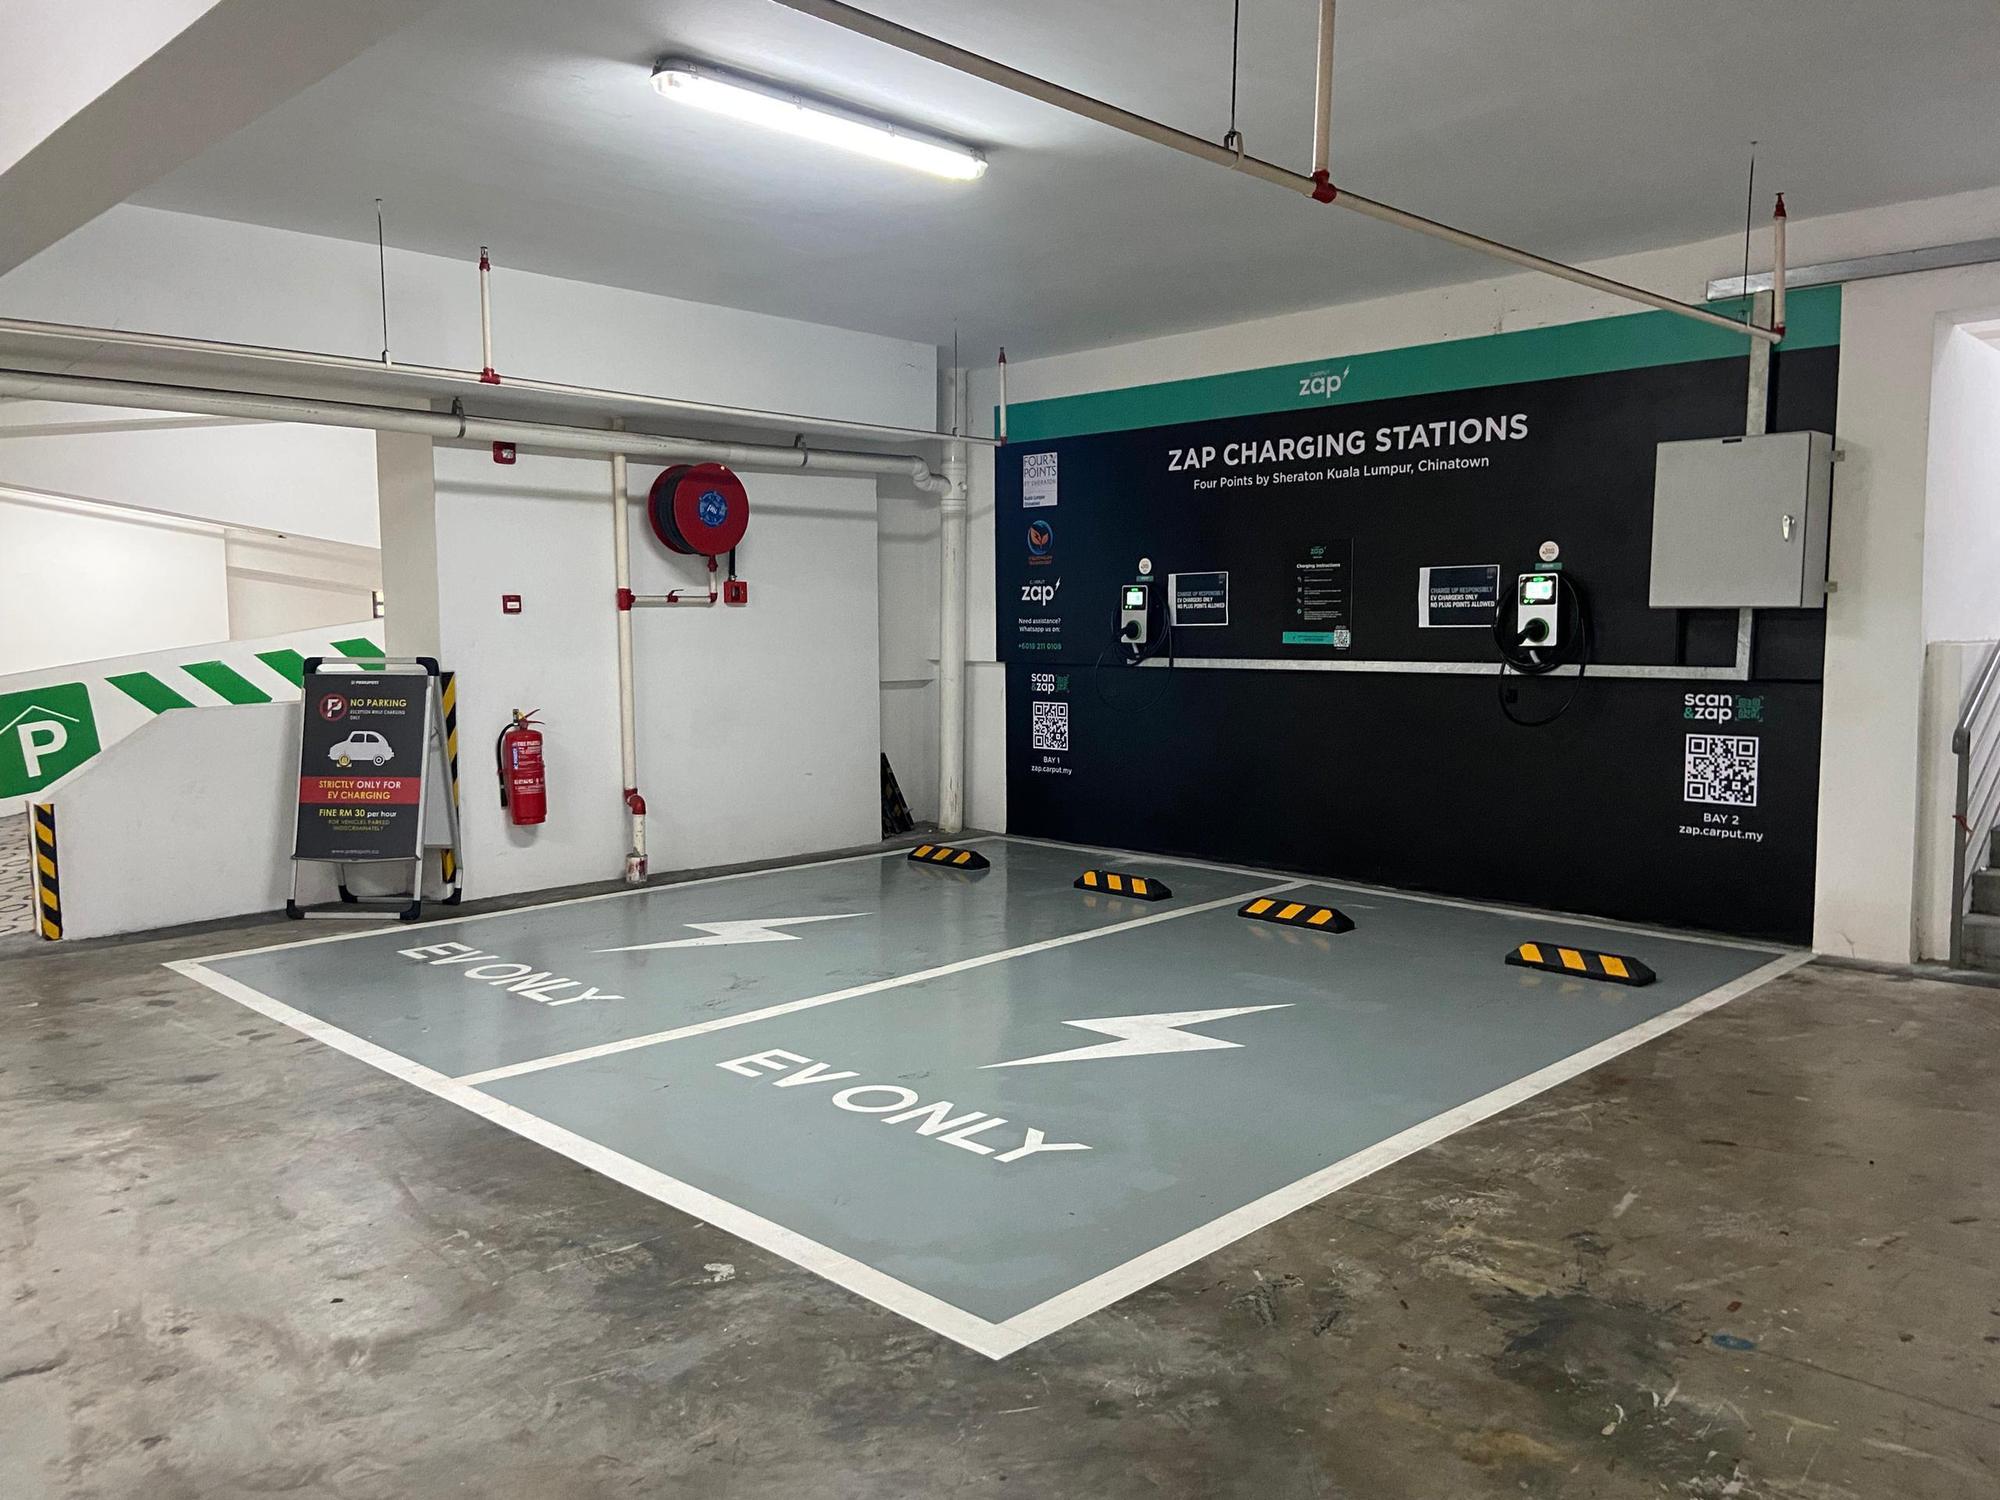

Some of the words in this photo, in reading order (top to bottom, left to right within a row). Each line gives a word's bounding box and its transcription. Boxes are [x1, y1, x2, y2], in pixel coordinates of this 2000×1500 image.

[1299, 375, 1341, 399] zap
[1168, 446, 1216, 471] ZAP
[1223, 430, 1366, 466] CHARGING
[1375, 413, 1528, 452] STATIONS
[1023, 455, 1048, 467] FOUR
[1024, 466, 1057, 479] POINTS
[1194, 479, 1217, 490] Four
[1220, 475, 1253, 488] Points
[1256, 473, 1269, 486] by
[1273, 470, 1323, 484] Sheraton
[1327, 466, 1360, 479] Kuala
[1364, 462, 1414, 477] Lumpur,
[1418, 457, 1489, 472] Chinatown
[1021, 585, 1054, 606] zap
[1031, 673, 1055, 682] scan
[350, 699, 364, 707] NO
[367, 699, 407, 707] PARKING
[1684, 693, 1732, 707] scan
[1683, 707, 1732, 724] &zap
[17, 720, 68, 778] P
[1043, 755, 1056, 763] BAY
[1031, 765, 1072, 775] zap.carput.my
[319, 780, 354, 789] STRICTLY
[356, 780, 381, 789] ONLY
[383, 780, 402, 789] FOR
[328, 791, 339, 799] EV
[340, 791, 391, 800] CHARGING
[319, 808, 337, 817] FINE
[339, 808, 353, 817] RM
[354, 808, 366, 817] 30
[380, 810, 397, 818] hour
[1703, 812, 1729, 824] BAY
[1731, 815, 1740, 825] 2
[1679, 824, 1764, 843] zap.carput.my
[397, 941, 499, 965] EV
[464, 962, 625, 1007] ONLY
[716, 1048, 861, 1089] EV
[832, 1084, 1093, 1163] ONLY
